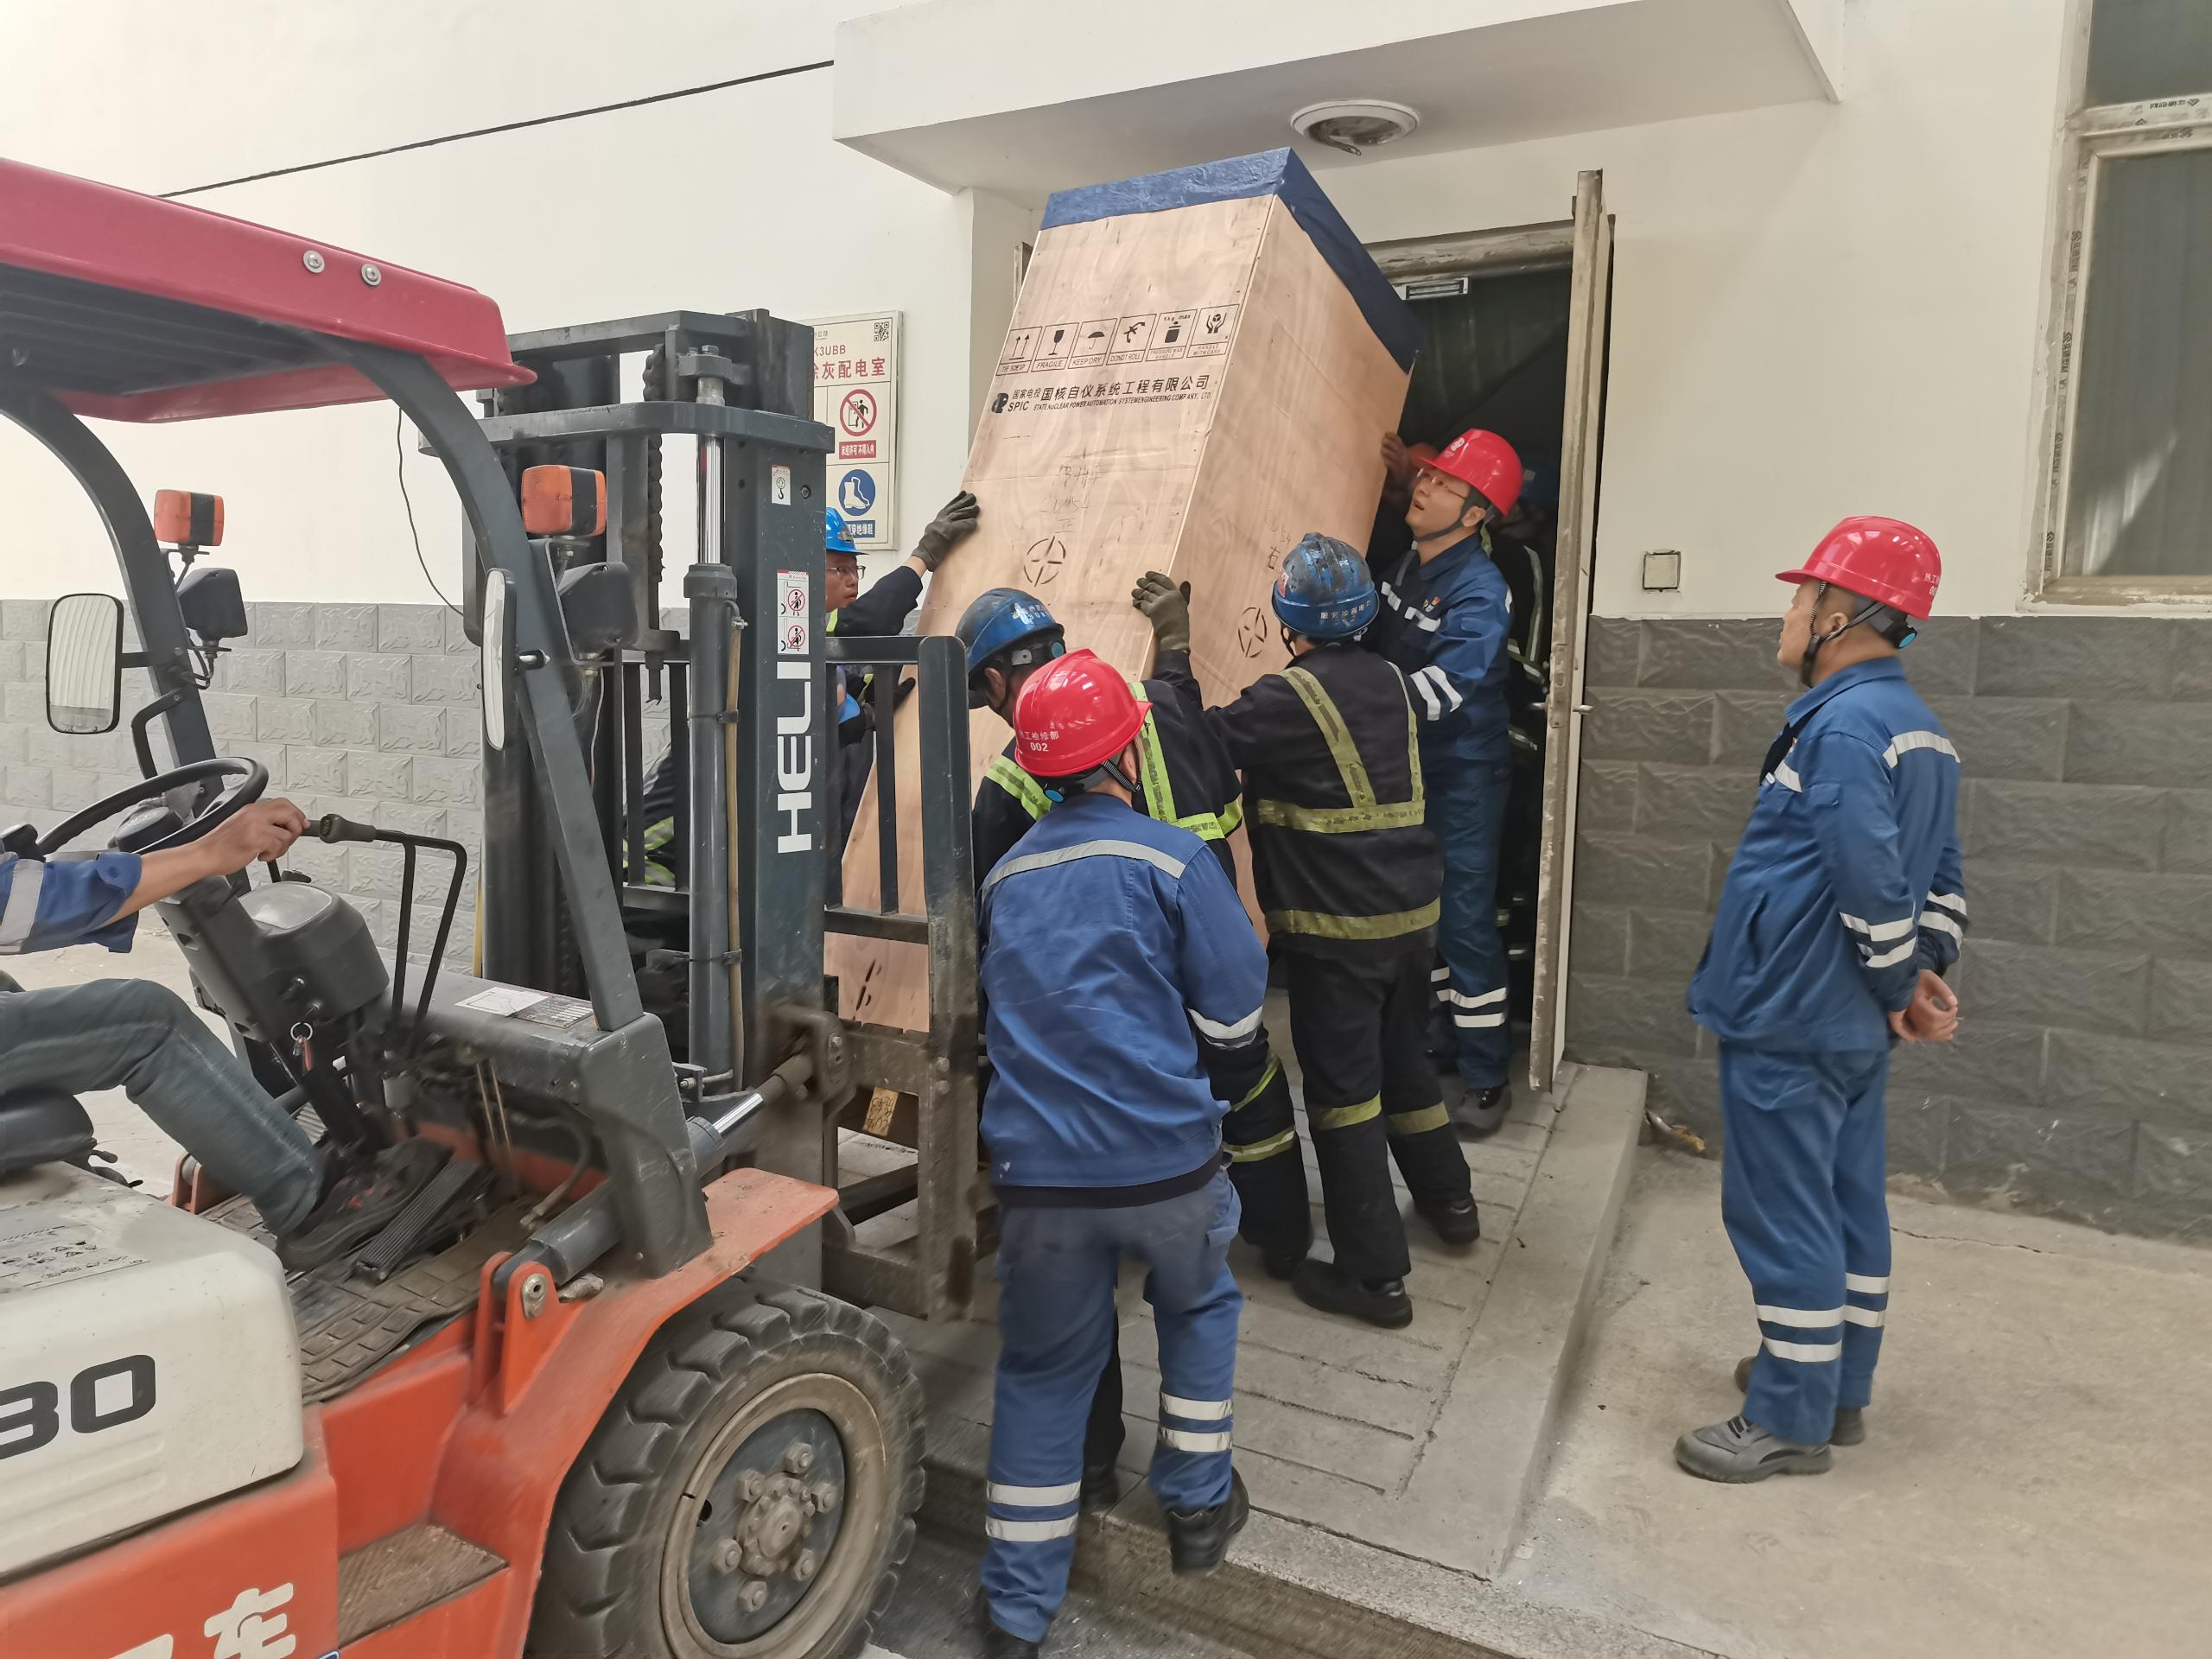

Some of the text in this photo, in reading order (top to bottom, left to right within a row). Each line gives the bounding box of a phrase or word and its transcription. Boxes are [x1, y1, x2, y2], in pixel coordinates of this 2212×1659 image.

[1037, 359, 1063, 368] FRAGILE
[1007, 401, 1029, 412] SPIC
[1030, 742, 1049, 752] 002
[777, 662, 811, 854] HELI
